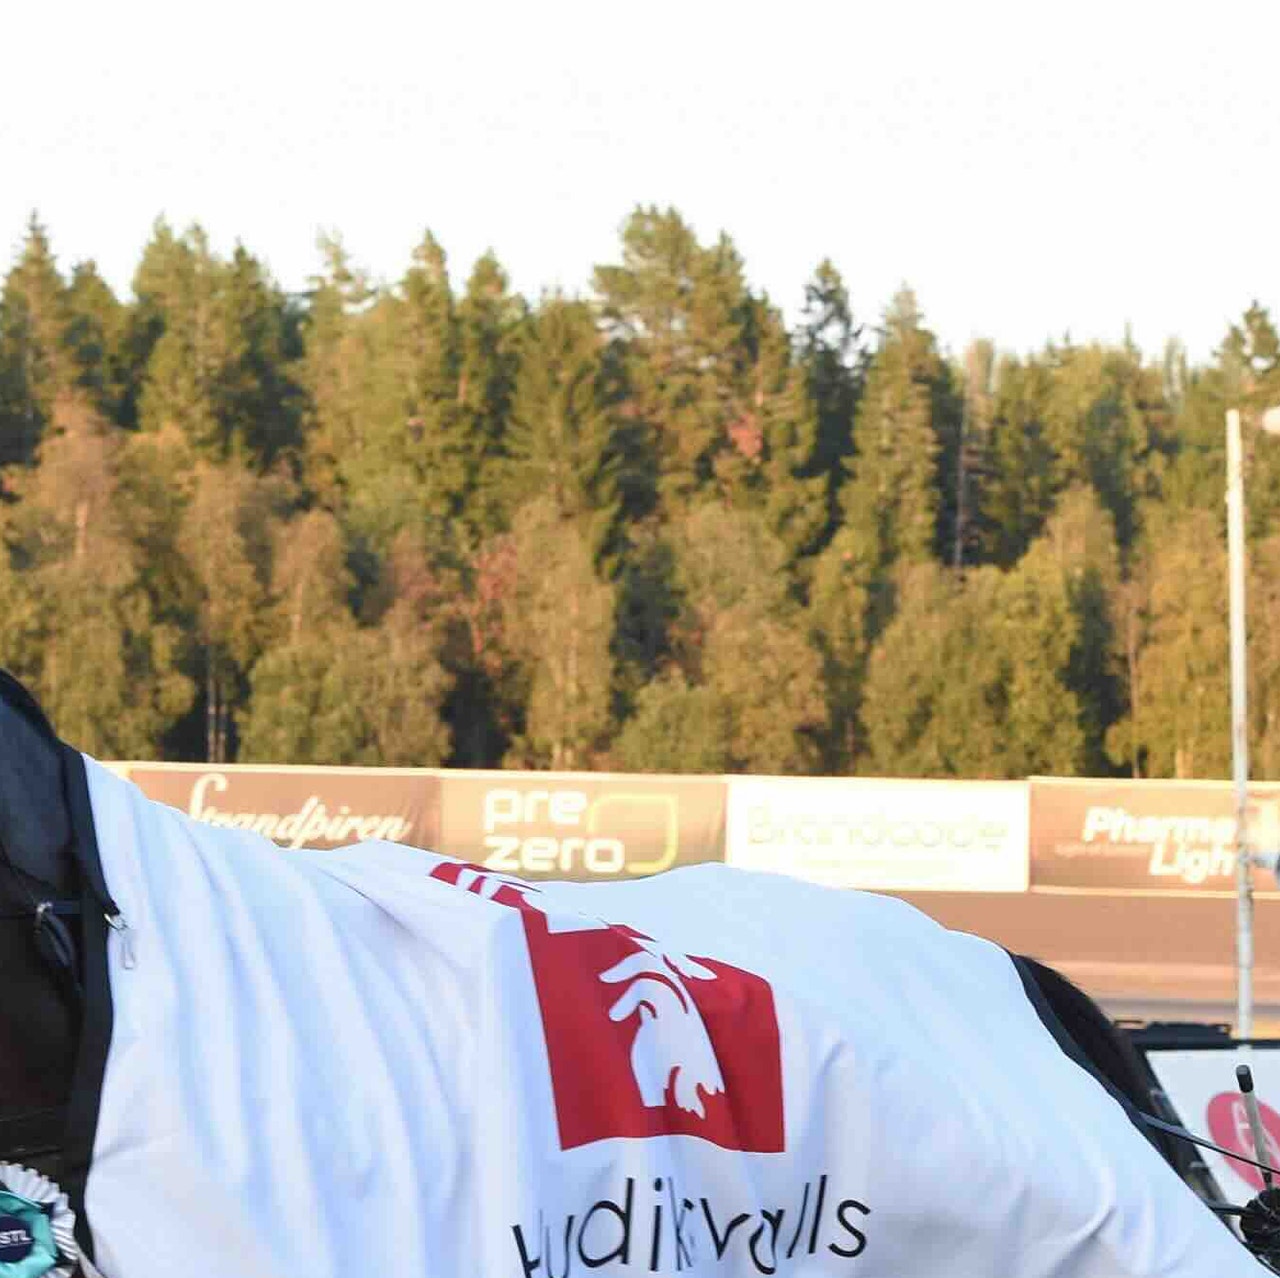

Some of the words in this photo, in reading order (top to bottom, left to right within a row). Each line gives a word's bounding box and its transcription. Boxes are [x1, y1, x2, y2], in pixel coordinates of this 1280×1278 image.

[484, 789, 588, 833] pre
[1082, 806, 1238, 843] Pharma
[484, 836, 625, 873] zero
[1149, 842, 1238, 884] Ligh
